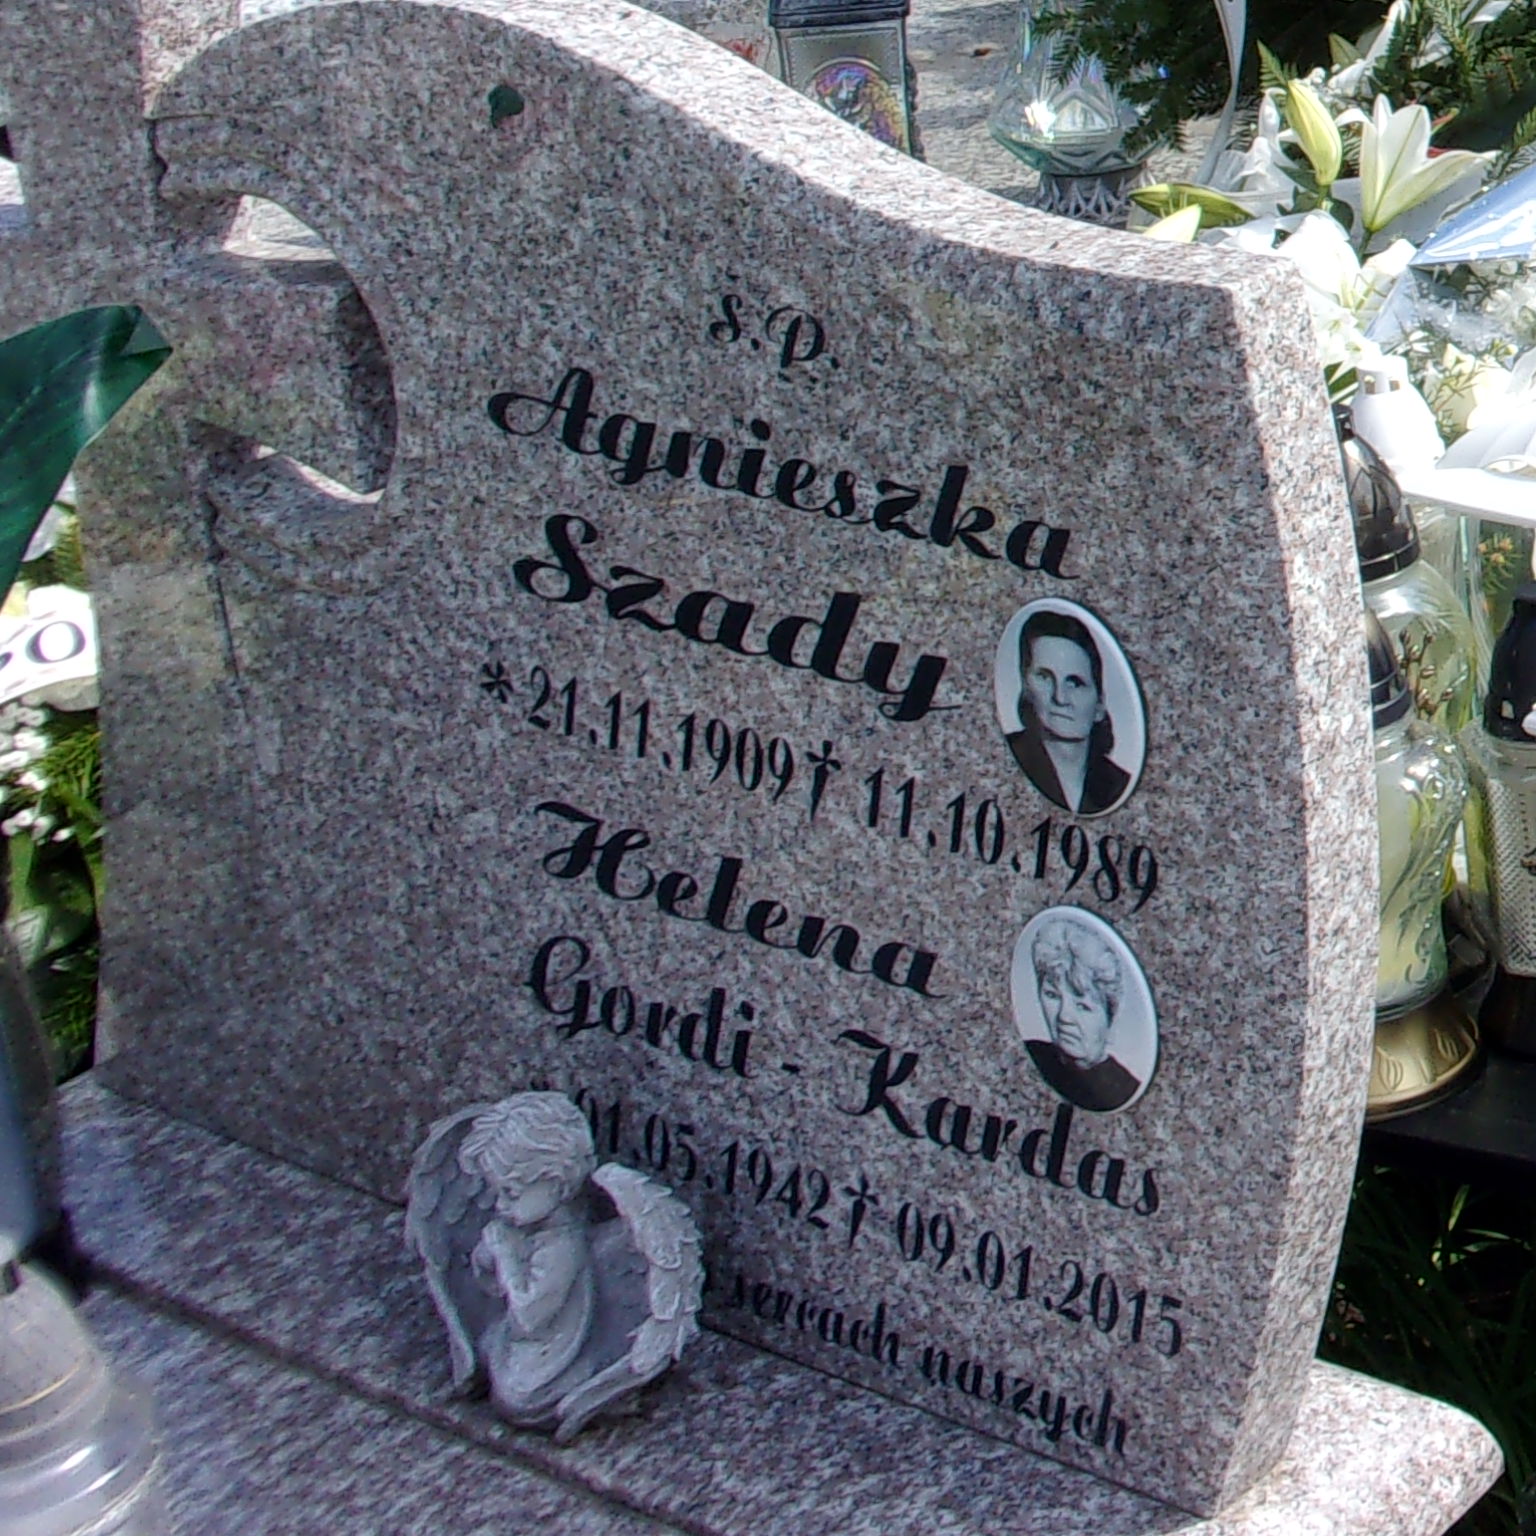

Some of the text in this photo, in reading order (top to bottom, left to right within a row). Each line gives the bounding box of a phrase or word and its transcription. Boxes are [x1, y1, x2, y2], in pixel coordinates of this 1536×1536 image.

[487, 366, 1081, 581] Agnieszka
[512, 513, 963, 723] Szady
[534, 800, 948, 999] Helena
[823, 1027, 1163, 1218] Kardas
[896, 1206, 1186, 1360] 09.01.2015
[918, 1340, 1132, 1455] naszych
